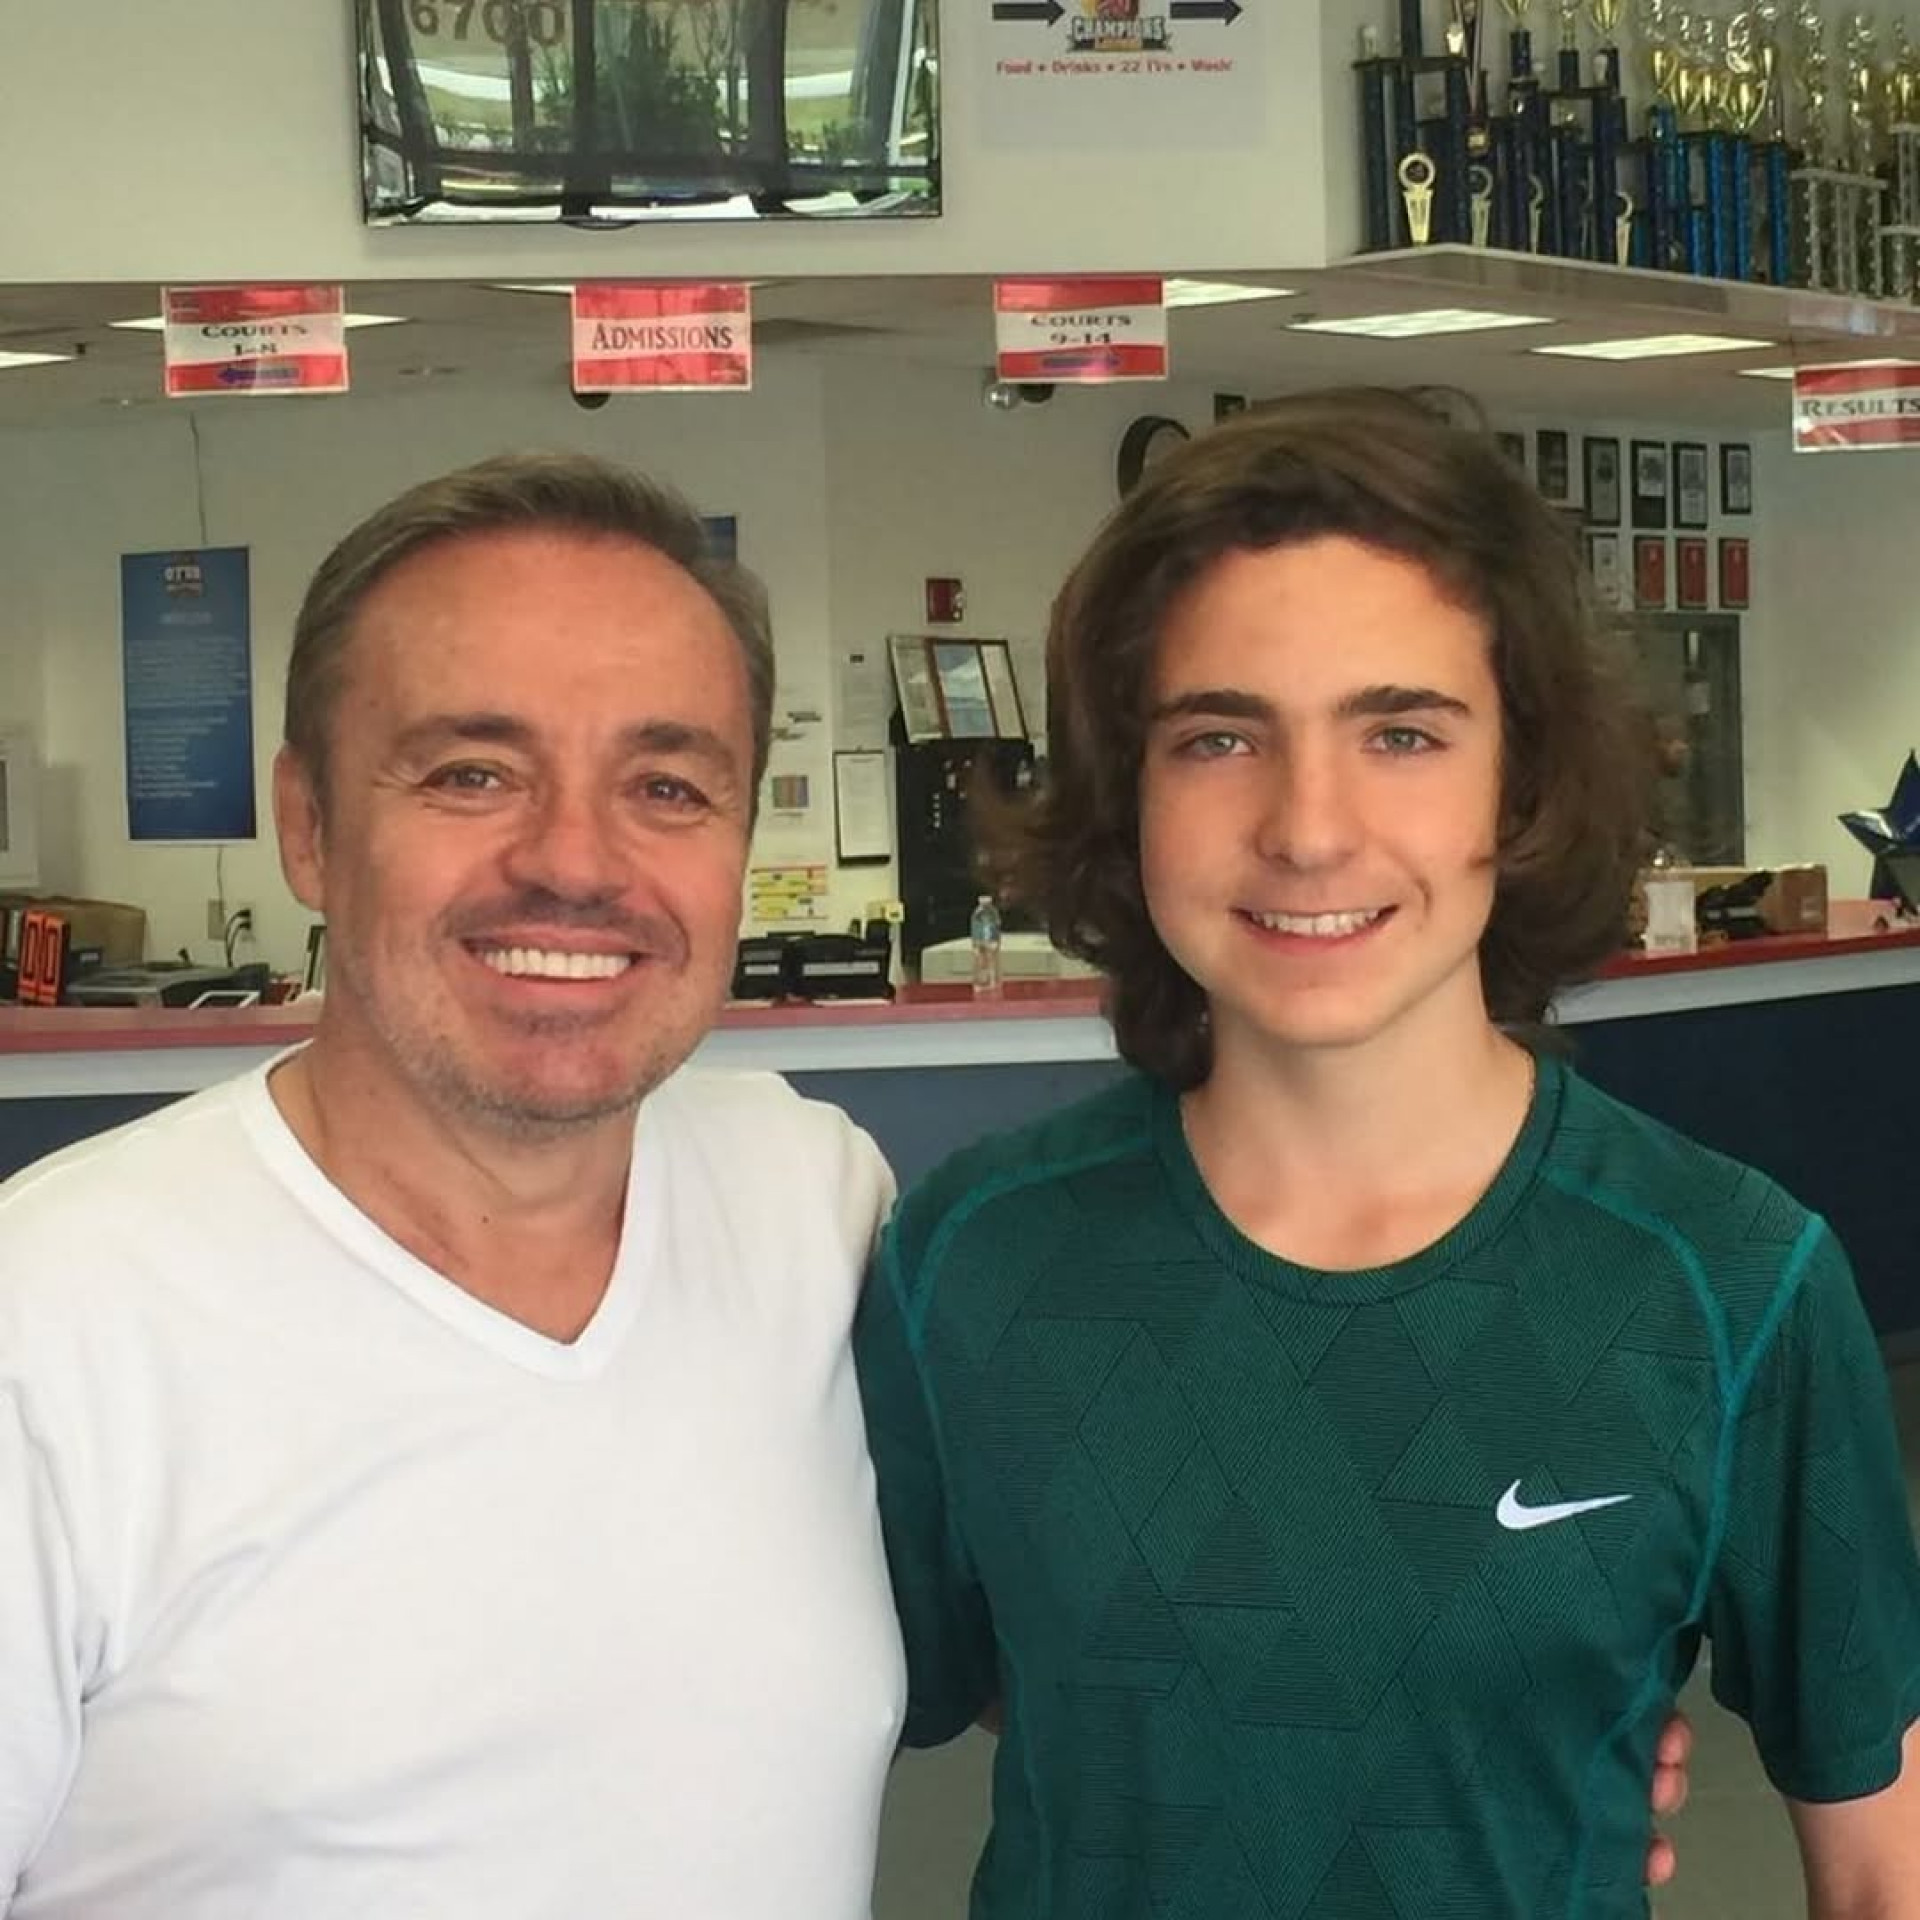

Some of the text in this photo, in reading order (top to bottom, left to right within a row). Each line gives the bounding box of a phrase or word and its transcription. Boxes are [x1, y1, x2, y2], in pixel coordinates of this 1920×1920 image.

[1071, 15, 1166, 41] CHAMPIONS
[997, 59, 1033, 74] Food
[1052, 58, 1101, 76] Drinks
[1120, 59, 1140, 73] 22
[1191, 57, 1233, 73] Music
[1030, 314, 1133, 327] COURTS
[592, 322, 734, 351] ADMISSIONS
[1051, 332, 1112, 345] 9-14
[1801, 397, 1920, 417] RESULTS
